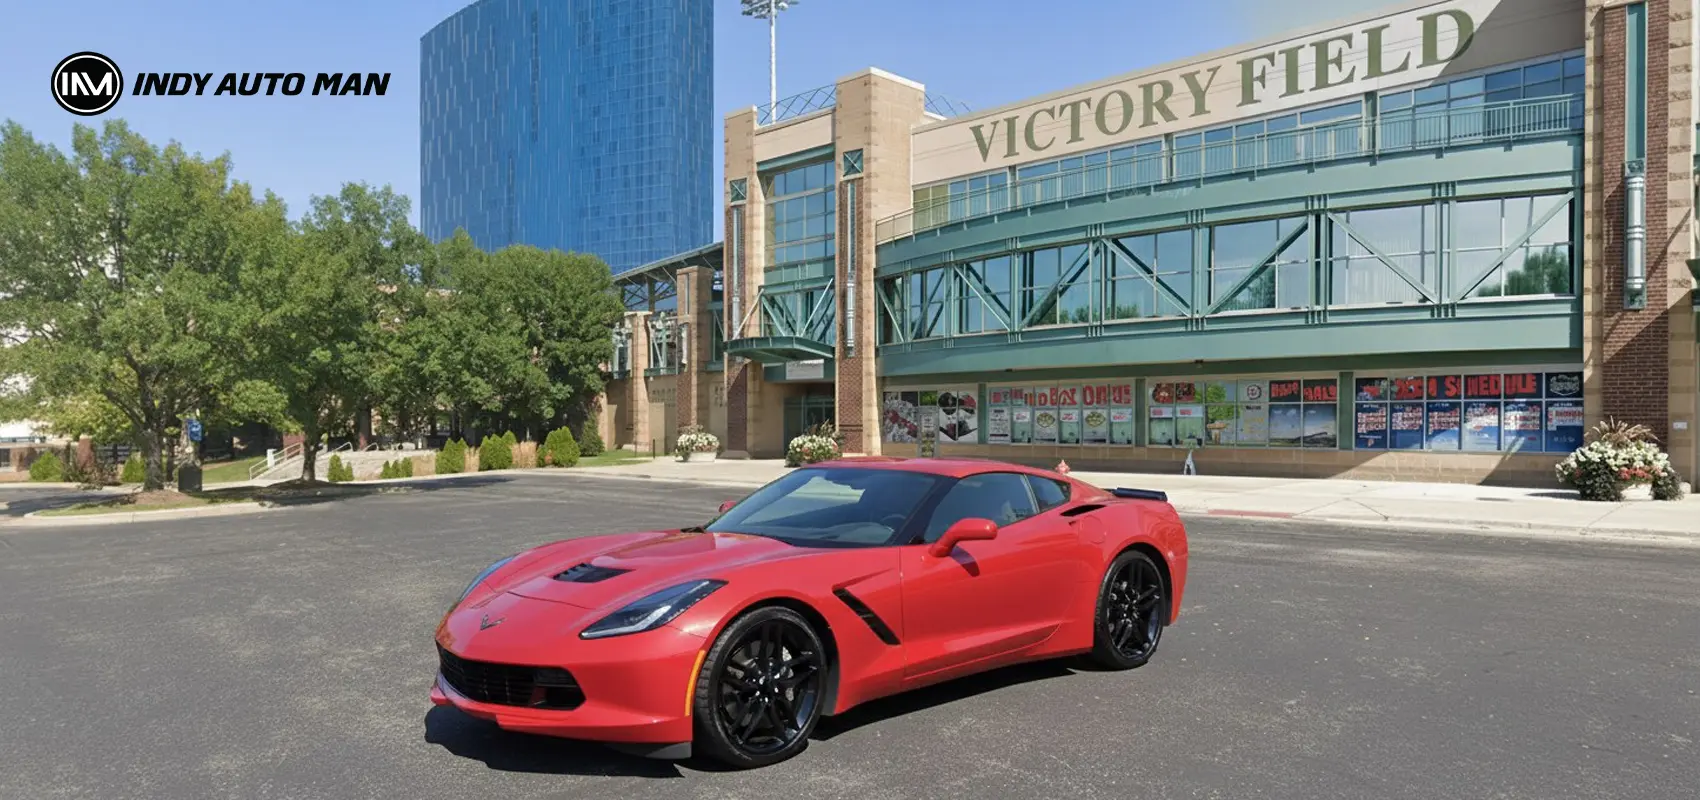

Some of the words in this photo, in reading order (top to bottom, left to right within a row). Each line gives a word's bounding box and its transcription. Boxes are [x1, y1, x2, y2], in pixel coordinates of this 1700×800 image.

[969, 65, 1222, 163] VICTORY
[1236, 8, 1475, 107] FIELD
[1444, 373, 1537, 398] SHEDULE
